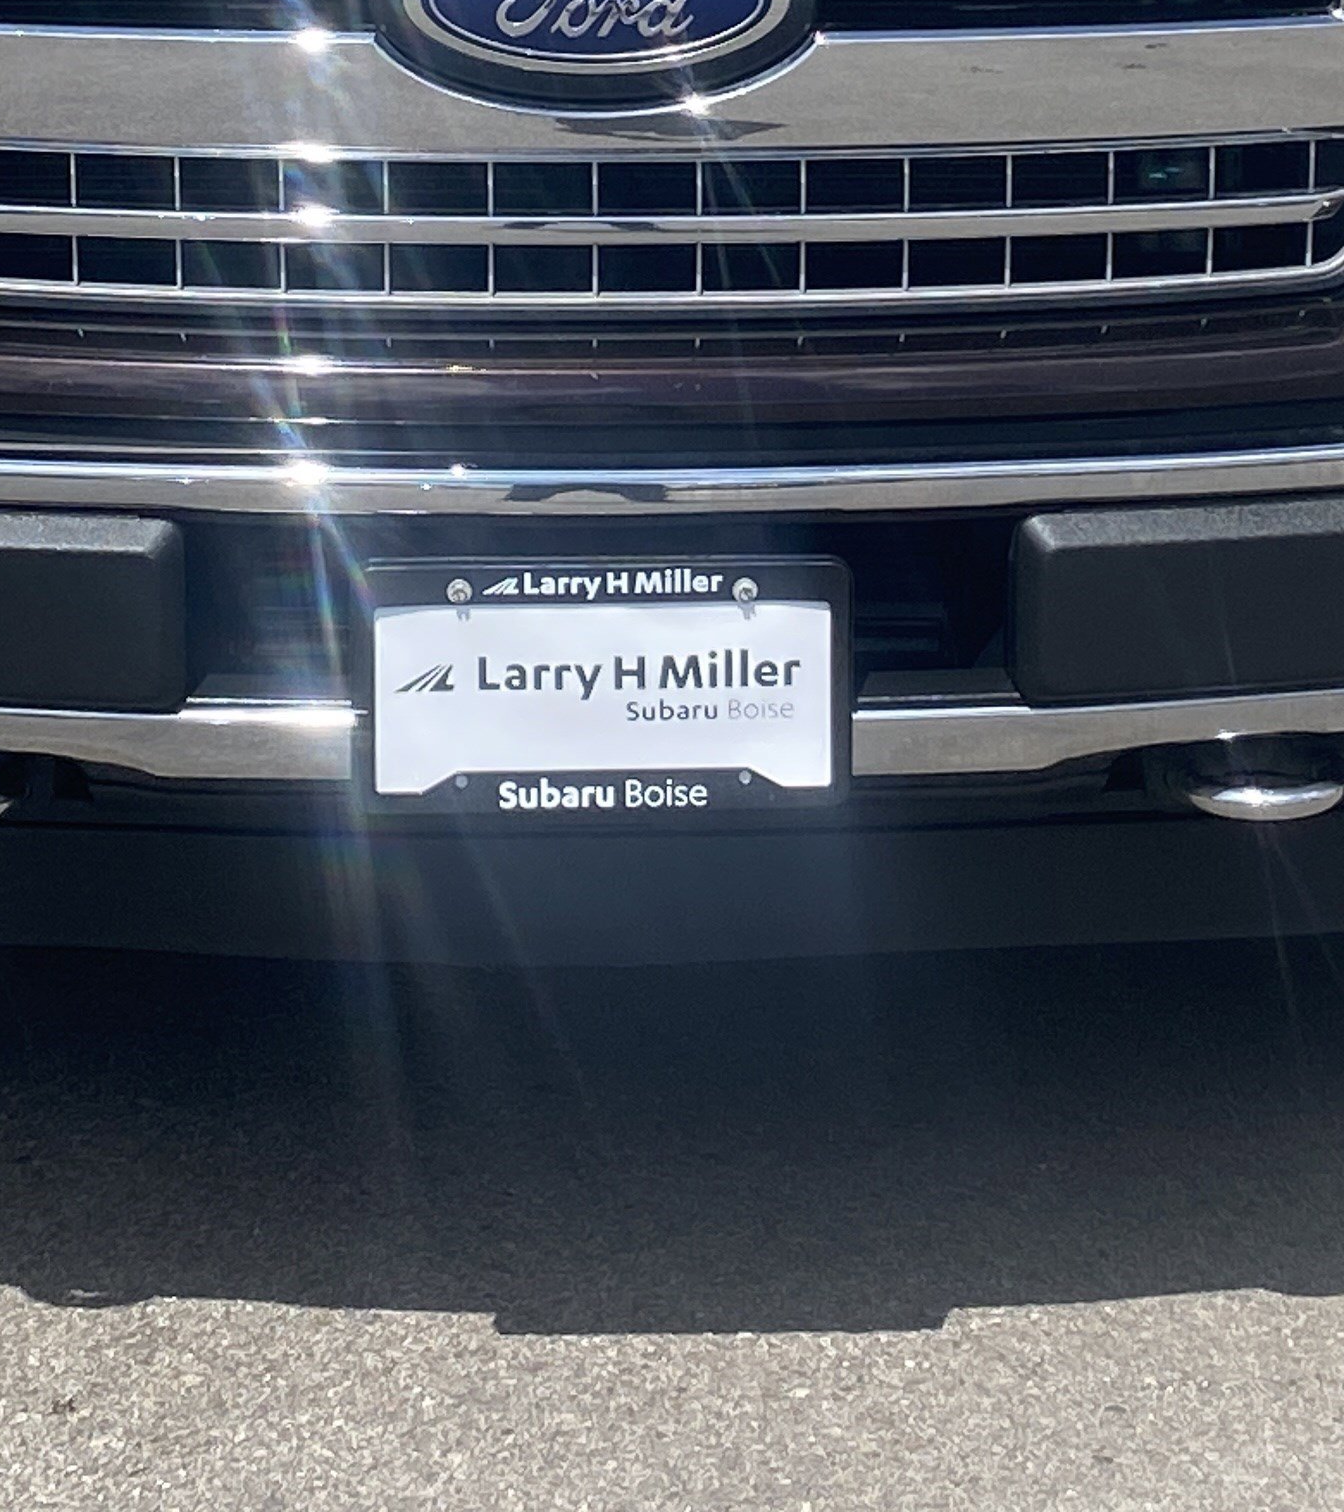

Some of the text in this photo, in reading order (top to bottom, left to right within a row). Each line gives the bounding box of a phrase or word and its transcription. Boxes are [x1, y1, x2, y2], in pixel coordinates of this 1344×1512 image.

[523, 569, 724, 600] Larry H Miller
[477, 648, 801, 700] Larry H Miller
[626, 698, 795, 721] Subaru Boise
[498, 778, 708, 809] Subaru Boise
